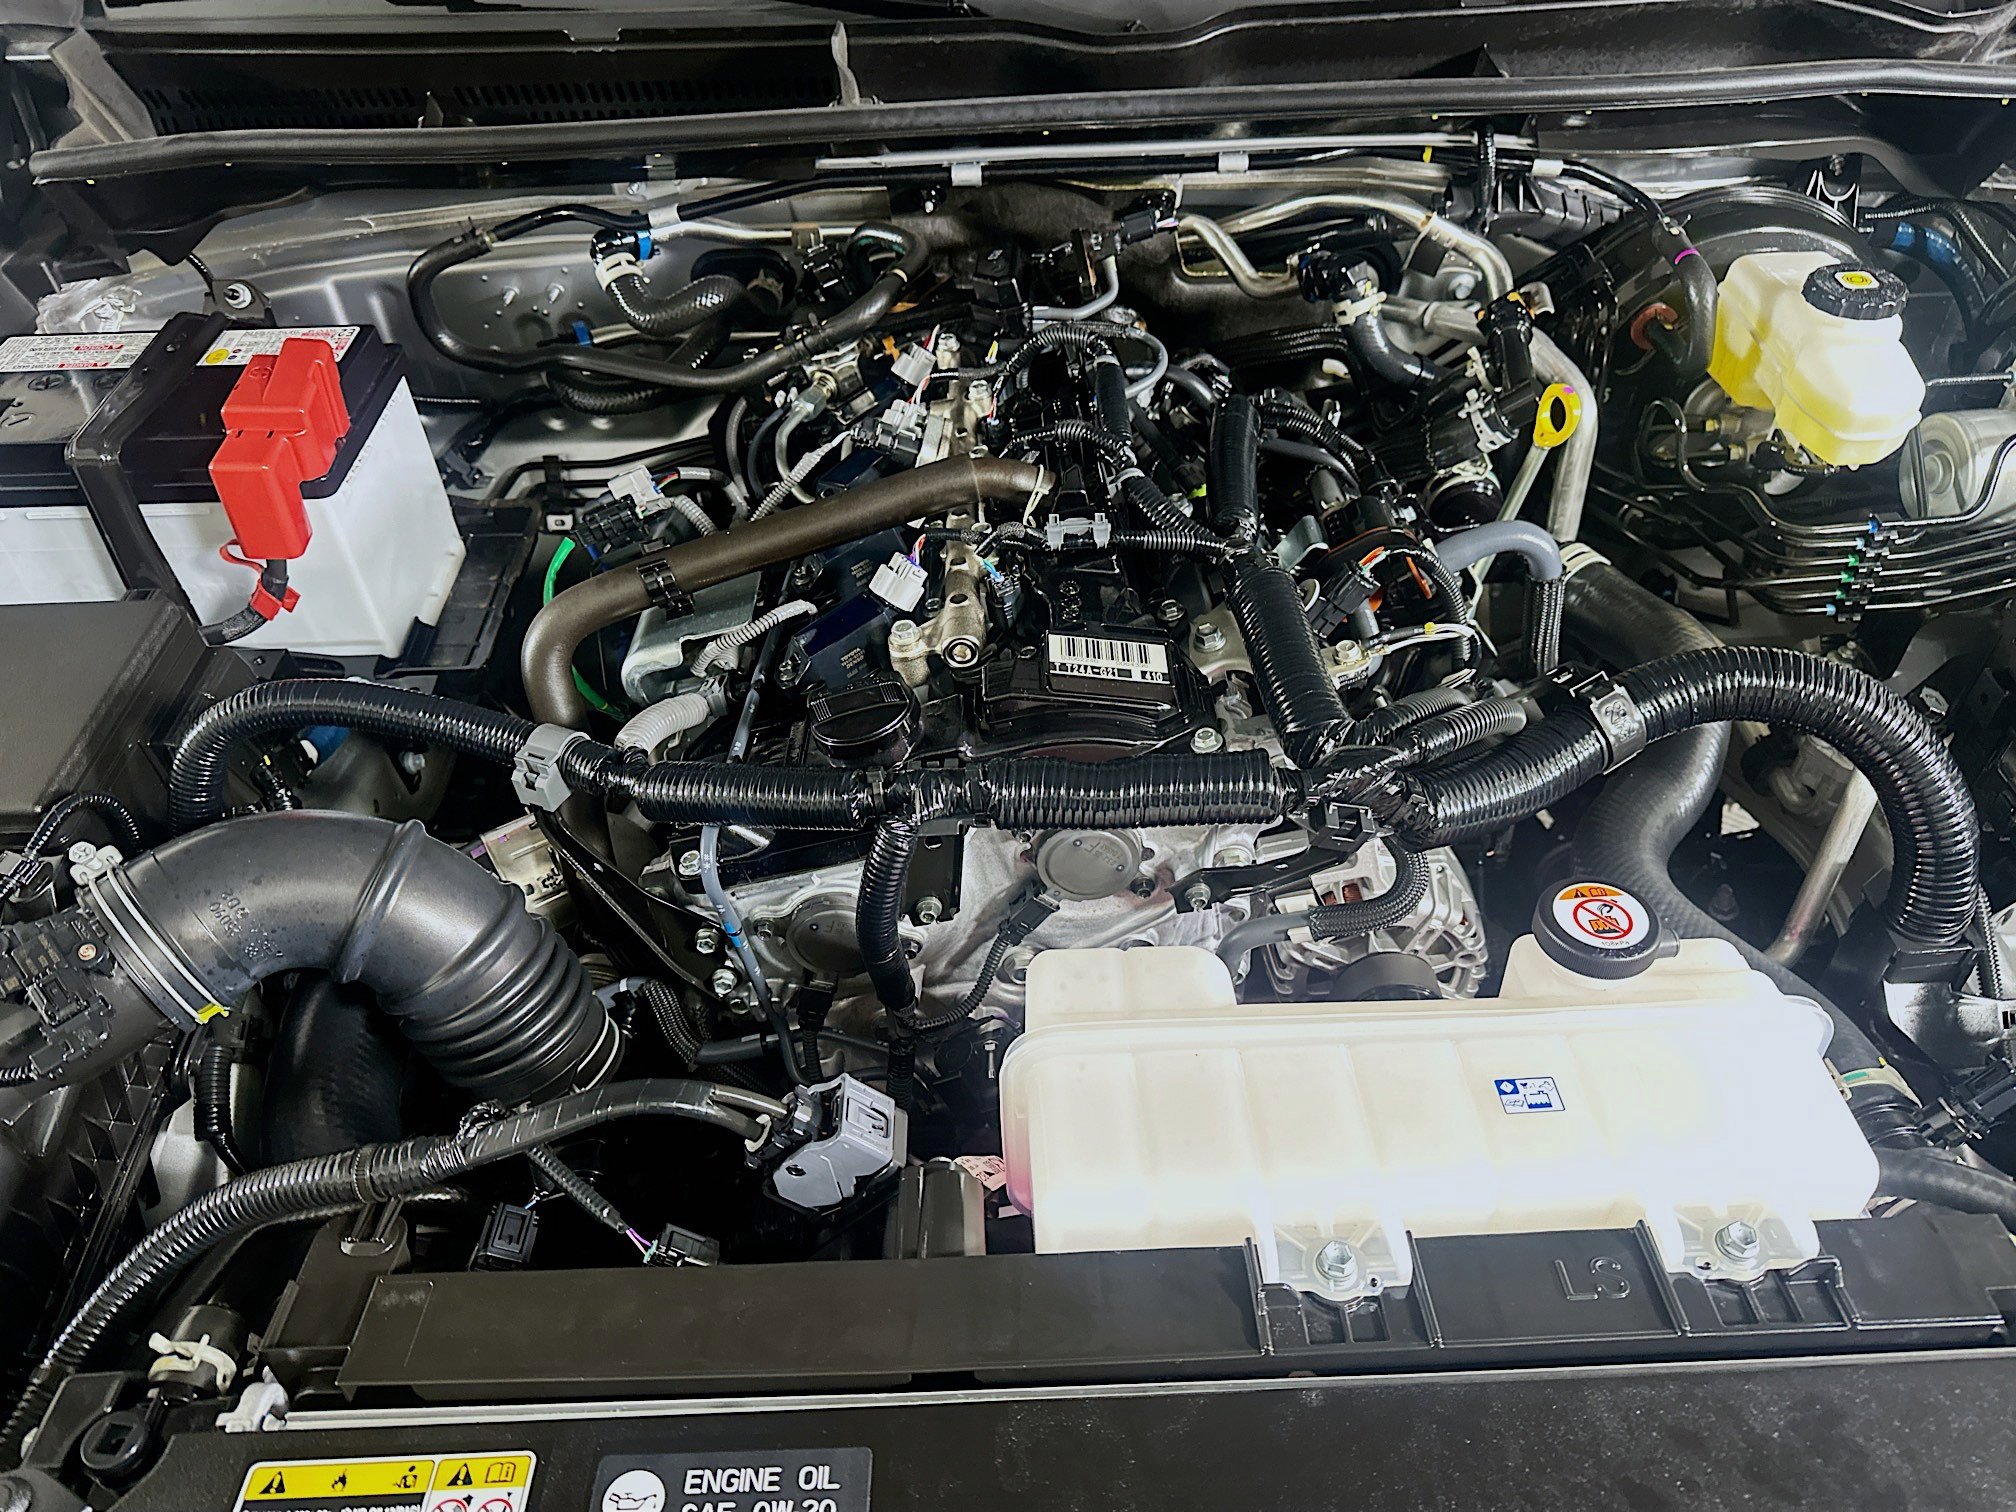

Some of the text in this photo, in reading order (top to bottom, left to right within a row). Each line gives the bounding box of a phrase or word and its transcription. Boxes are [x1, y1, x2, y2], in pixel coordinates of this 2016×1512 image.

[1066, 662, 1118, 678] T24A-G21
[1145, 671, 1163, 682] 410
[683, 1465, 841, 1495] ENGINE OIL
